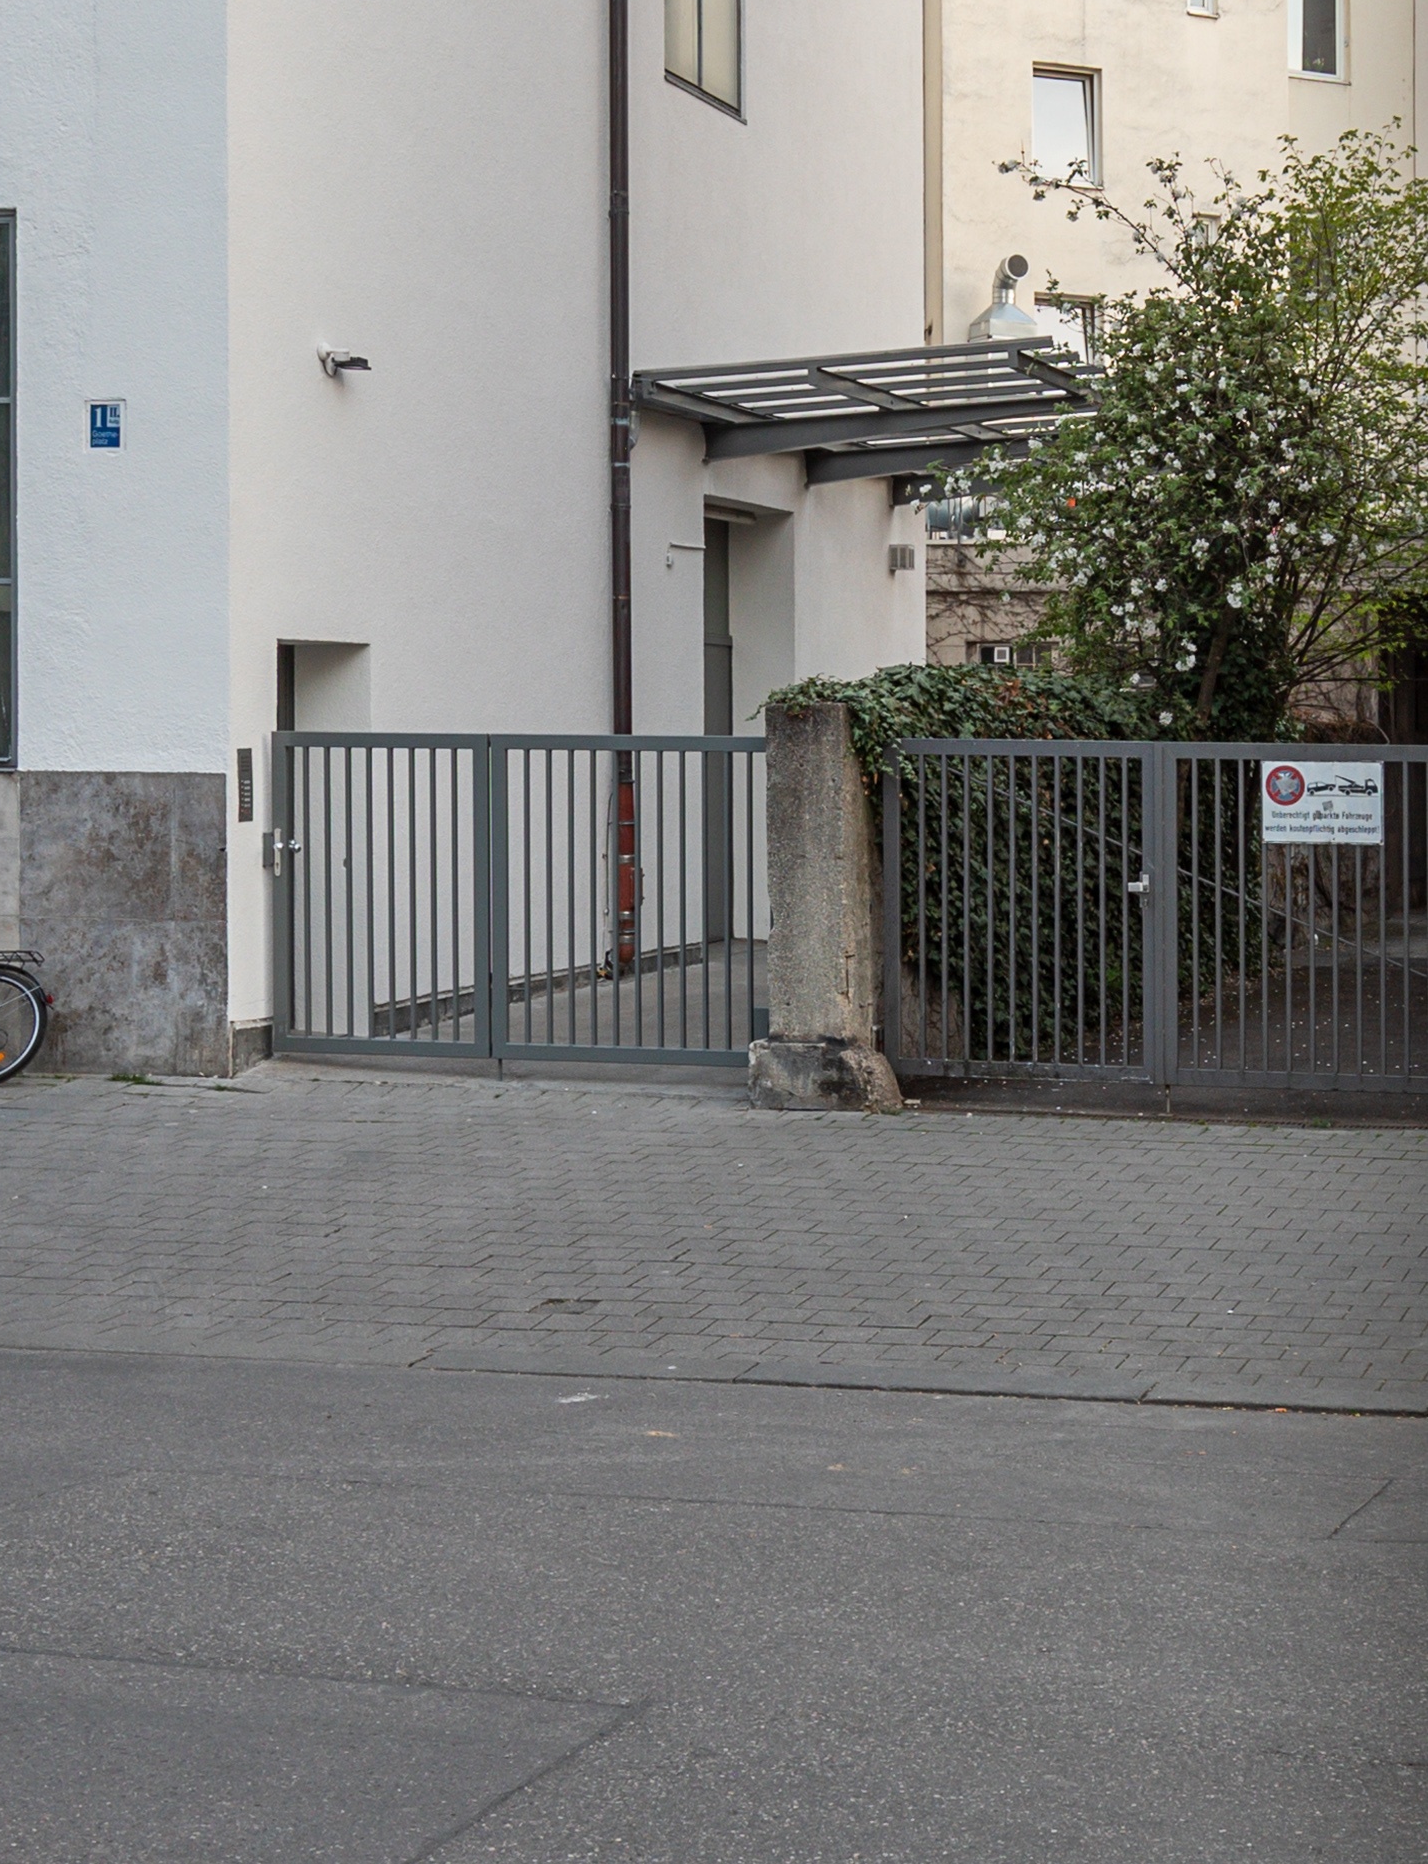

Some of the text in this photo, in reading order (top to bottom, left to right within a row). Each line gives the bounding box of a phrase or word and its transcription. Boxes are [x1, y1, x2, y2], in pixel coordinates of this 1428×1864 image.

[95, 407, 103, 427] 1
[1271, 811, 1310, 821] Unberechtigt
[1342, 812, 1373, 821] Fahrzeuge
[1265, 824, 1287, 832] werden
[1289, 824, 1335, 835] kostenpflichtig
